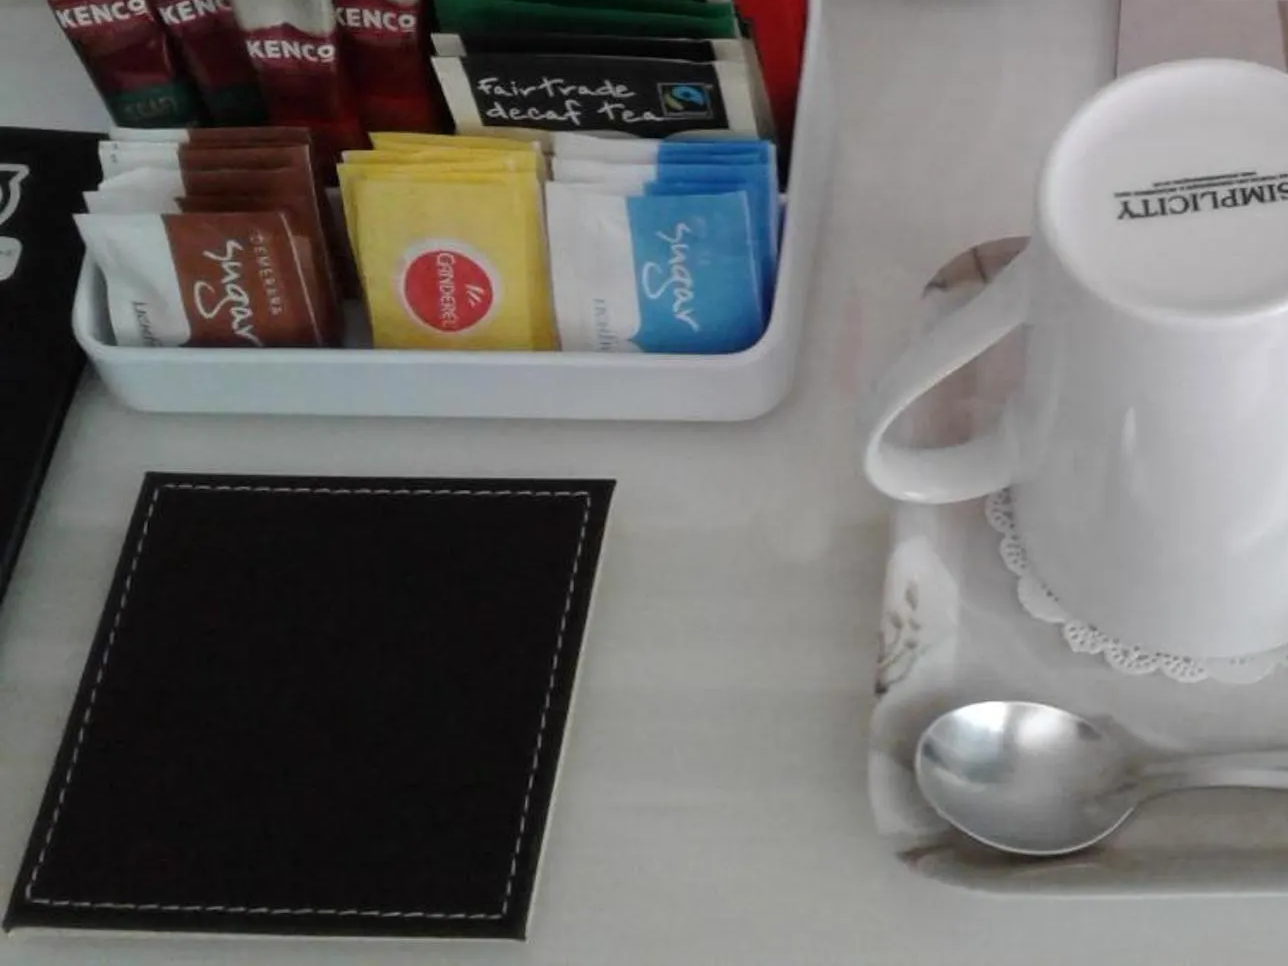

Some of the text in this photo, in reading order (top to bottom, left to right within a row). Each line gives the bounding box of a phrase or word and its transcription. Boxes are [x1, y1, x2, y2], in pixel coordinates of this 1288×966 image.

[477, 77, 636, 99] Fairtrade
[486, 99, 665, 126] decaf tea
[194, 238, 266, 347] sugar
[642, 222, 699, 332] sugar
